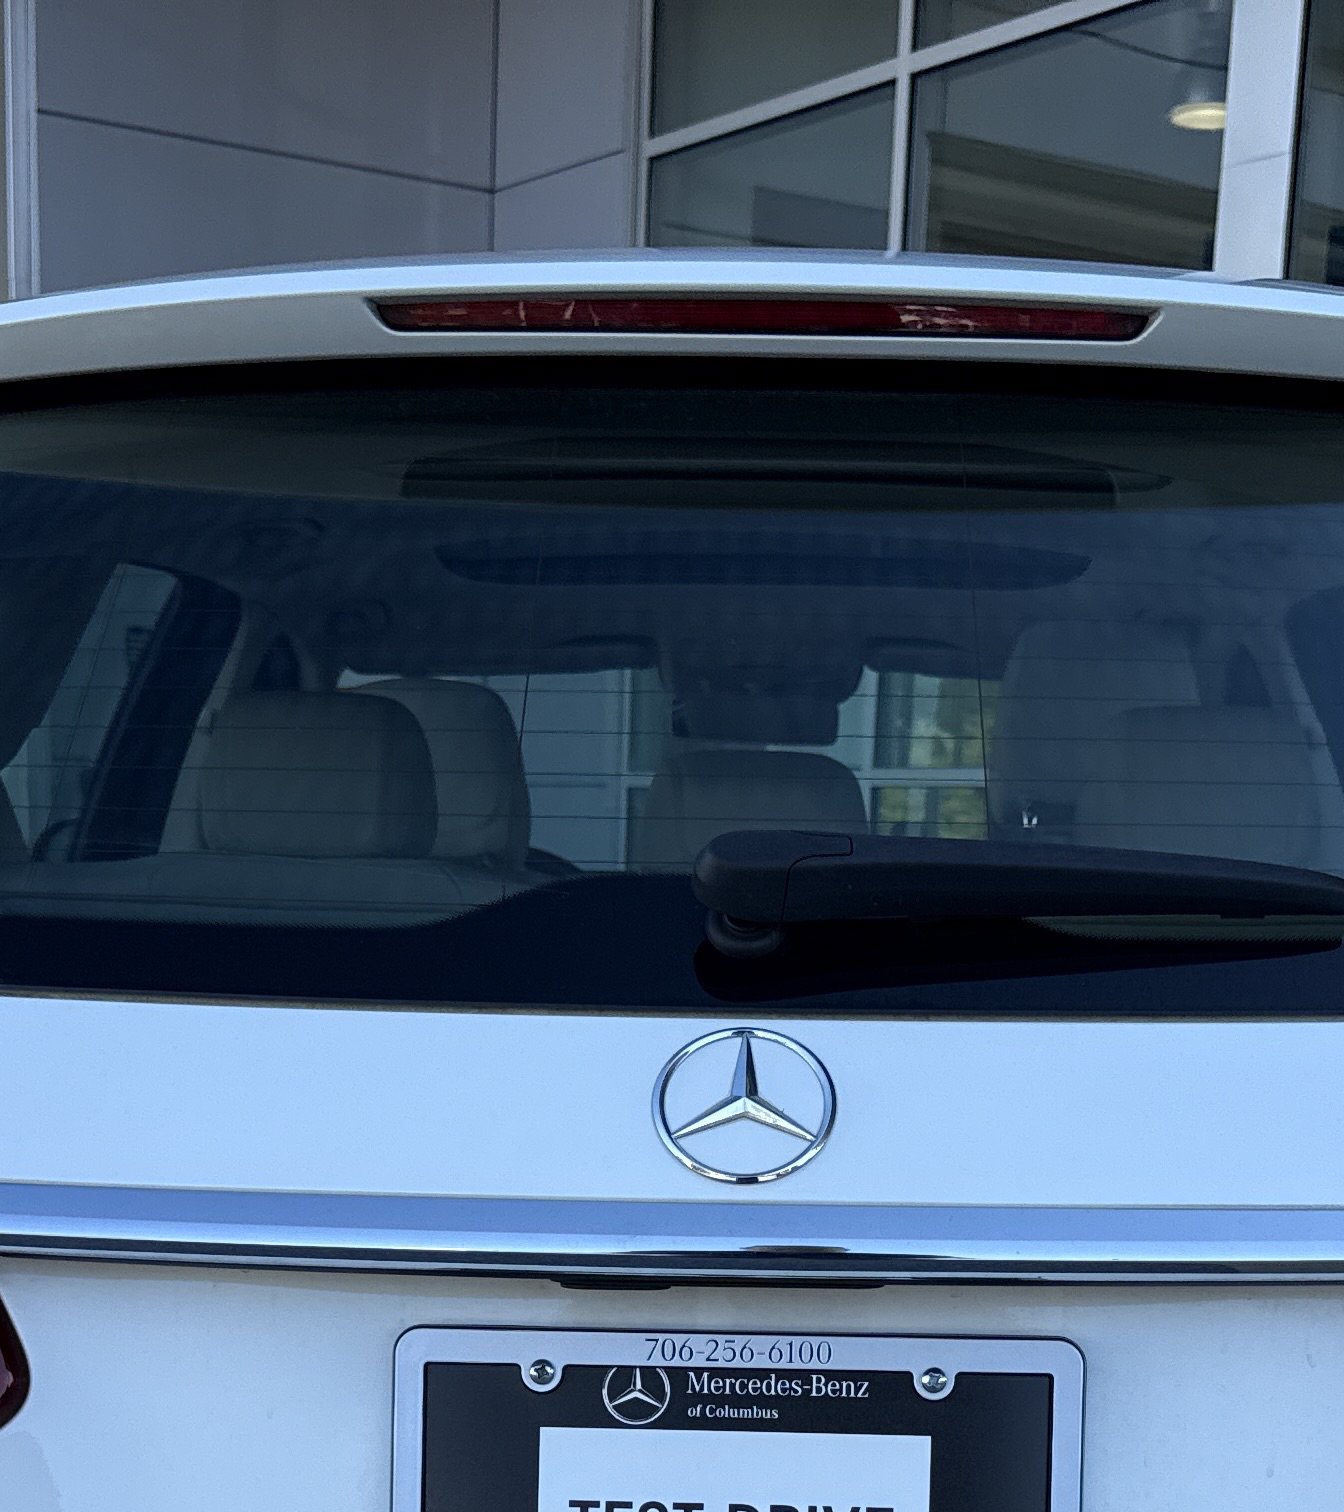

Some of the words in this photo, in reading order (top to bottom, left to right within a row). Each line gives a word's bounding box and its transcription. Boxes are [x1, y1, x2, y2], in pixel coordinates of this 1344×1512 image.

[644, 1337, 833, 1365] 706-256-6100
[686, 1371, 870, 1398] Mercedes-Benz
[687, 1404, 702, 1418] of
[705, 1404, 779, 1419] Columbus
